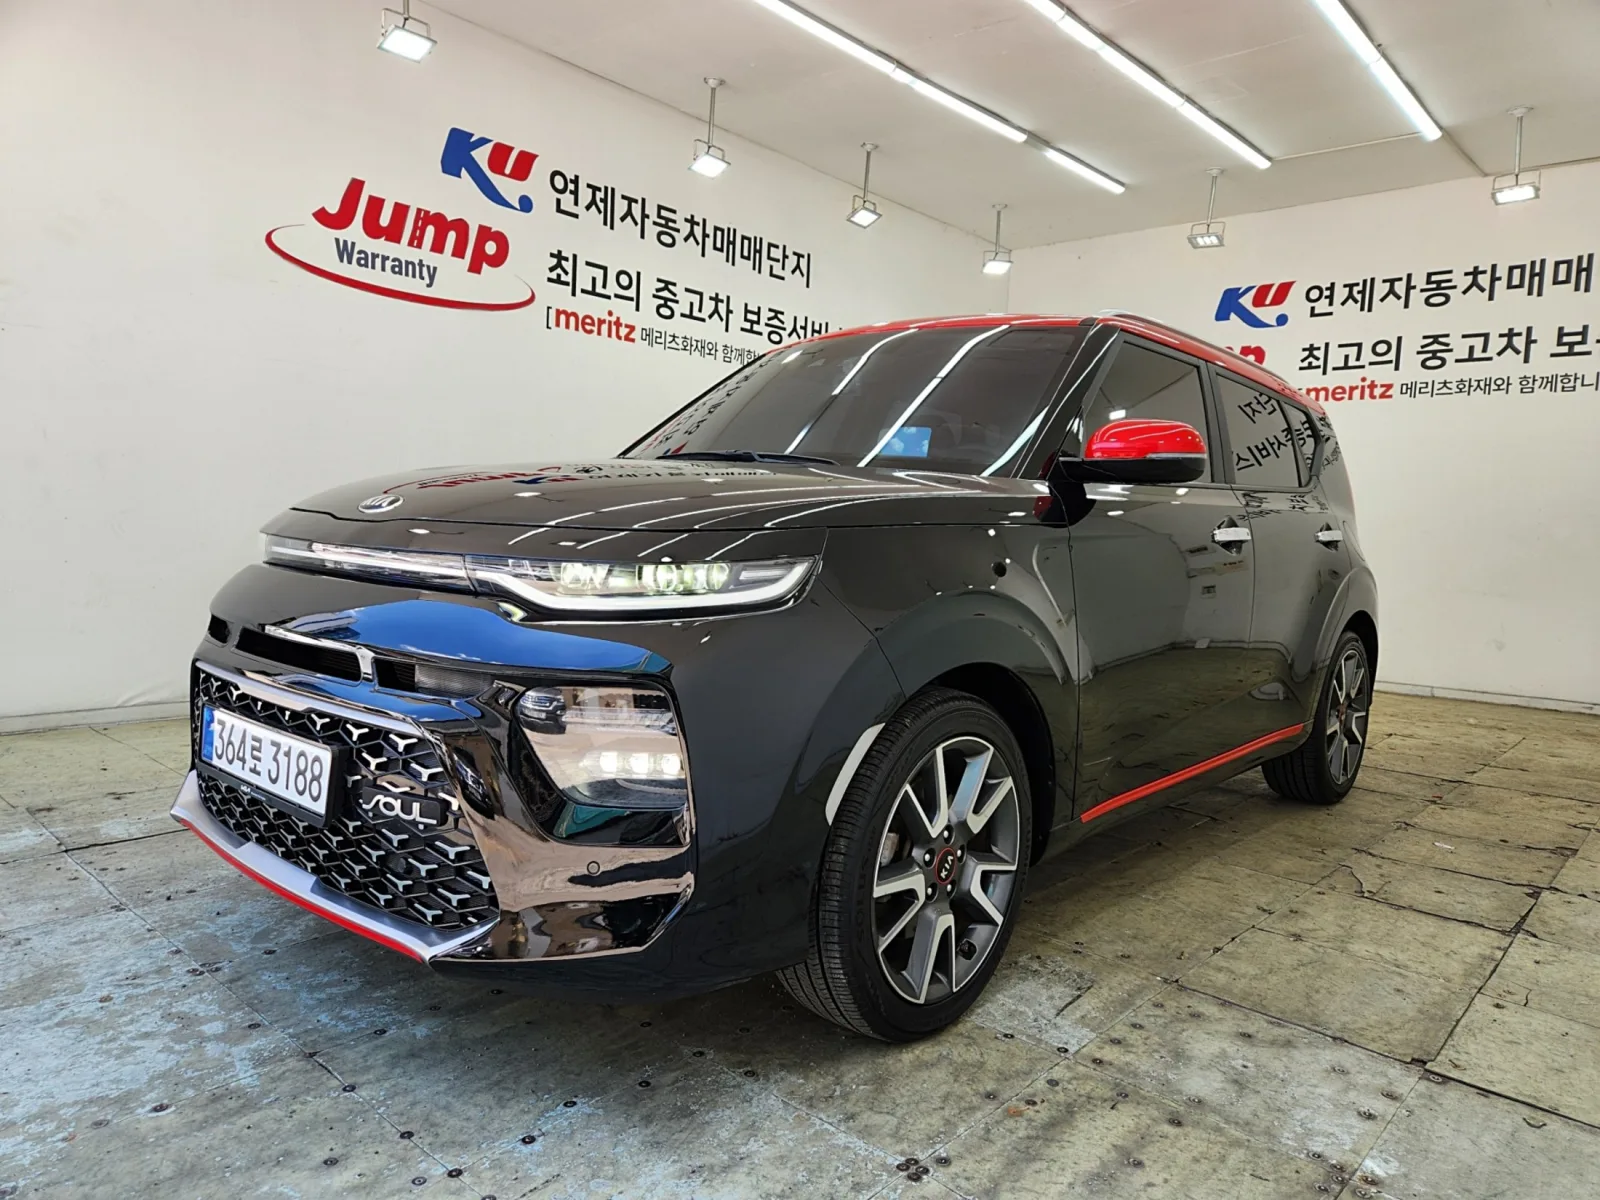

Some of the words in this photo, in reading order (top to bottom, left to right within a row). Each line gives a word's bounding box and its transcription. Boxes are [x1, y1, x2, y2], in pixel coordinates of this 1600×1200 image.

[312, 177, 510, 275] Jump
[549, 168, 812, 289] 연제자동차매매단지
[334, 237, 438, 288] Warranty
[1304, 253, 1595, 318] 연제자동차매매
[547, 249, 643, 312] 최고의
[652, 277, 734, 333] 중고차
[740, 302, 843, 345] 보증서비
[640, 326, 719, 361] 메리츠화재와
[1299, 335, 1403, 376] 최고의
[1416, 326, 1538, 371] 중고차
[1399, 374, 1512, 399] 메리츠화재와
[358, 794, 438, 825] SOUL
[940, 855, 954, 879] KIA
